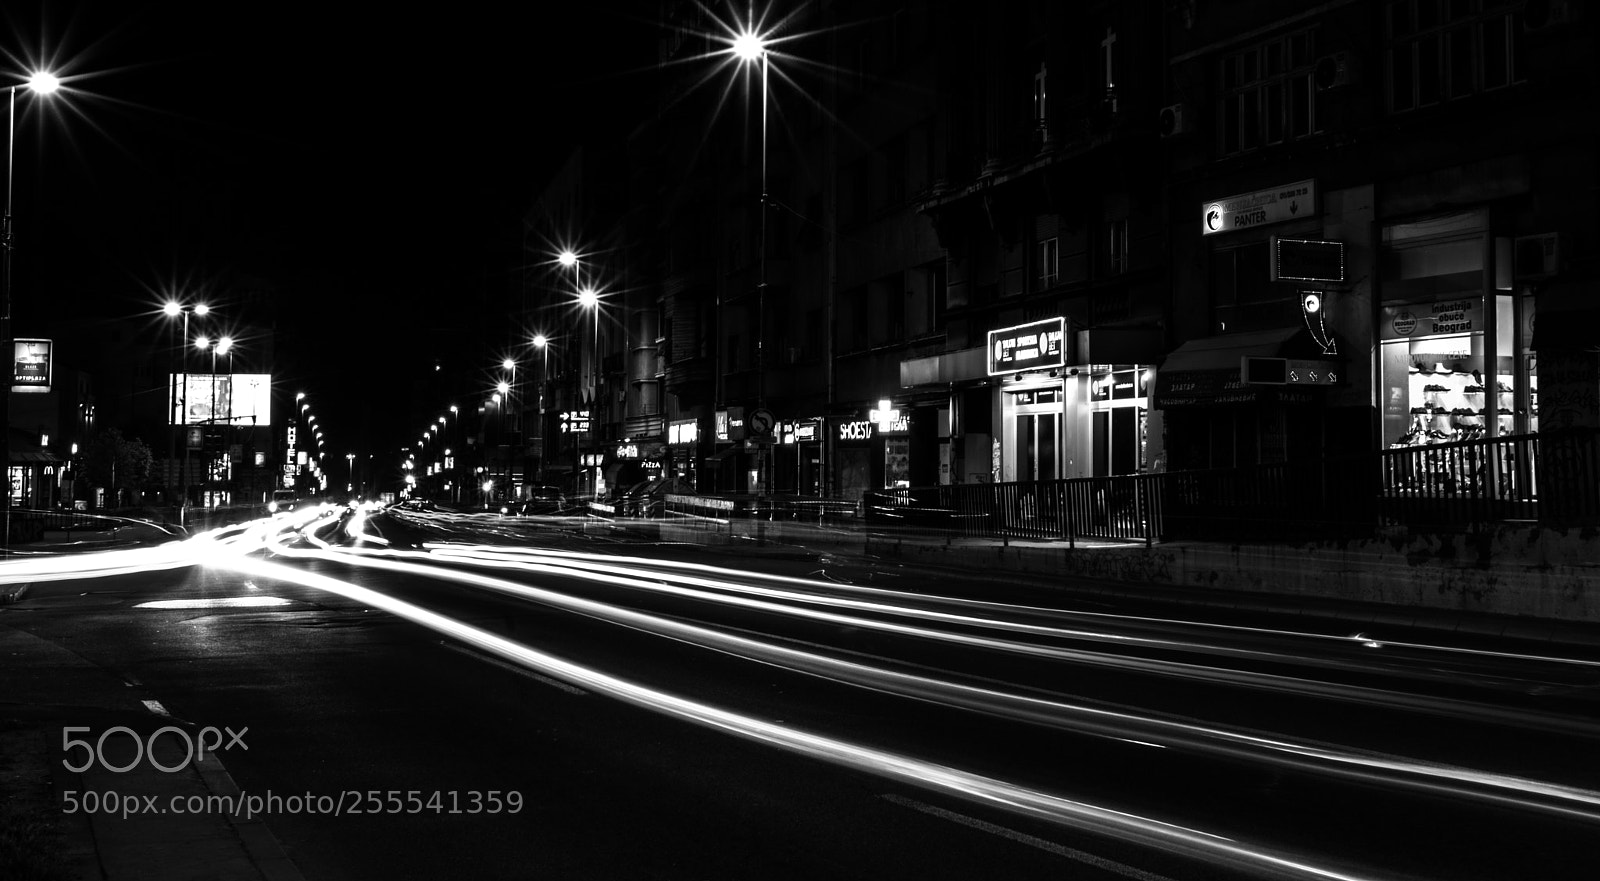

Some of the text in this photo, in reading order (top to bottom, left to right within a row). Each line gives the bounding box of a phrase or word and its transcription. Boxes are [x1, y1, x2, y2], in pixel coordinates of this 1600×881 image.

[1235, 210, 1266, 227] PANTER
[1432, 320, 1472, 333] Beograd
[287, 427, 296, 463] HOTEL
